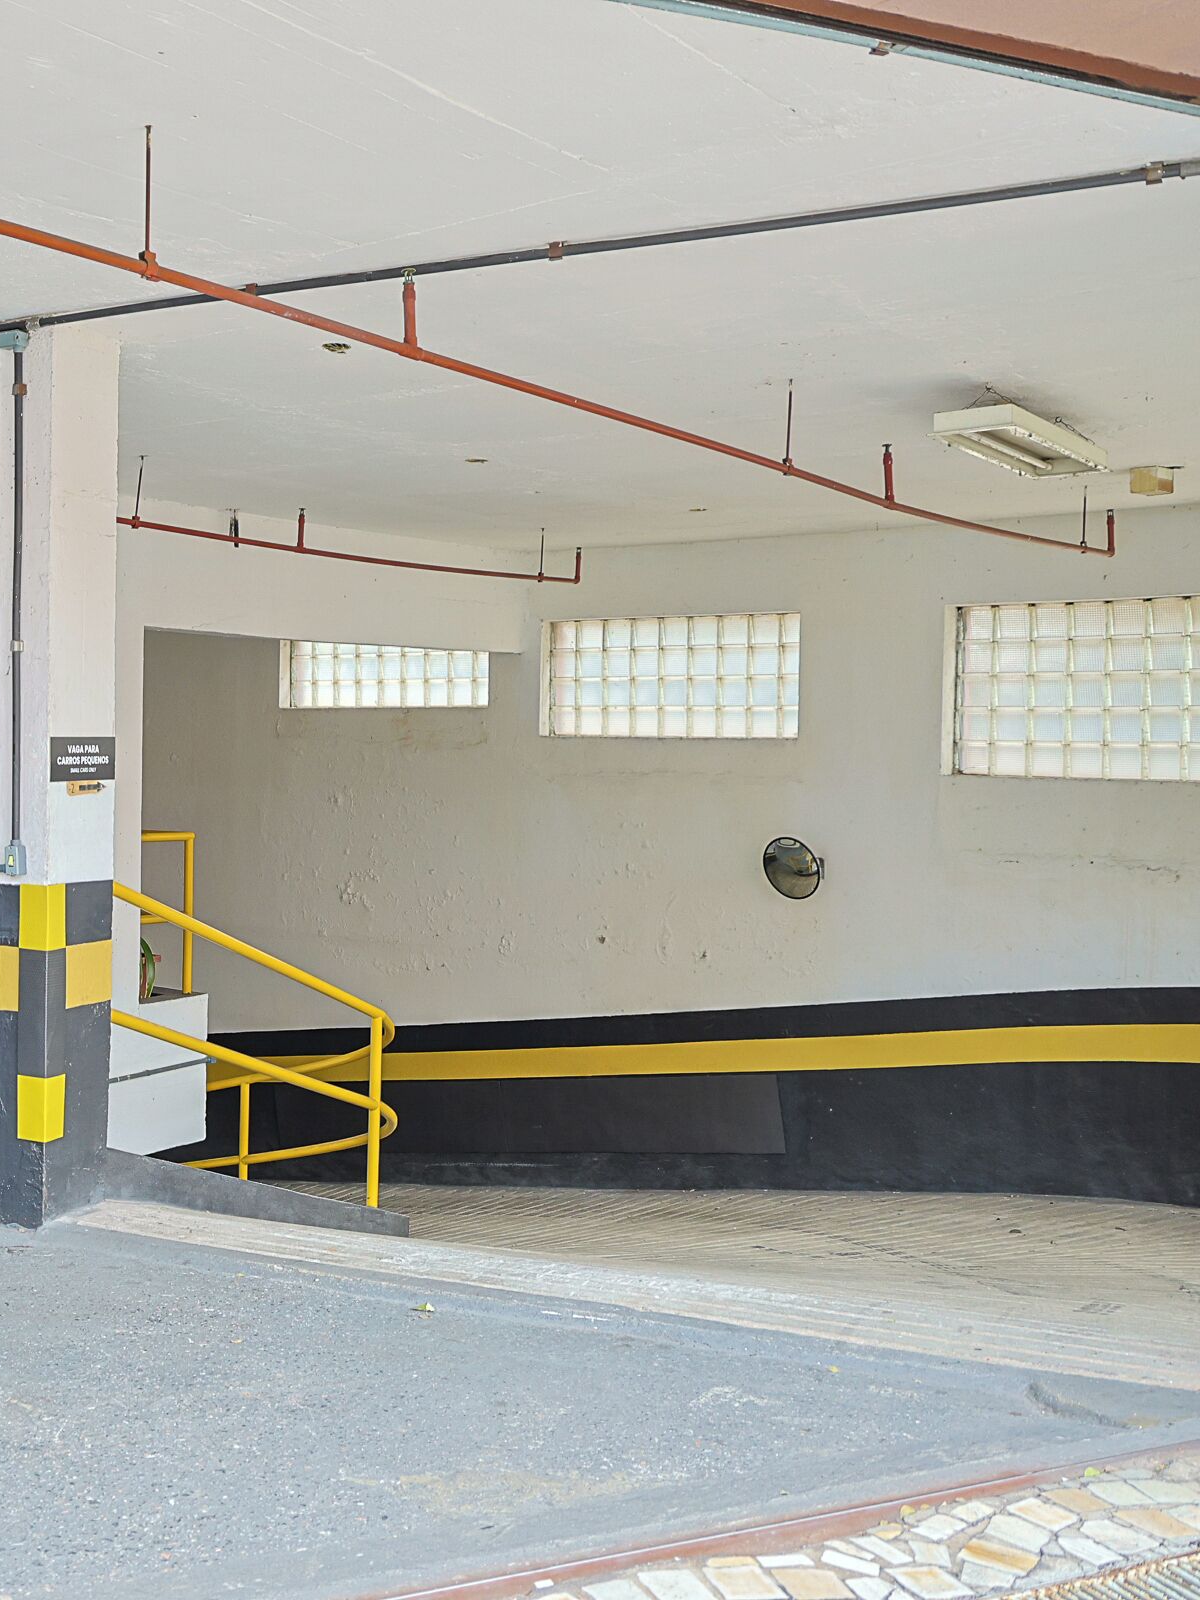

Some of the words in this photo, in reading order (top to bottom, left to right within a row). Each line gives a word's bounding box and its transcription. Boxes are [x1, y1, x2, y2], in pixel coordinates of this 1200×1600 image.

[67, 744, 84, 754] VAGA
[84, 744, 100, 754] PARA
[56, 756, 80, 765] CARROS
[80, 755, 109, 766] PEQUENOS
